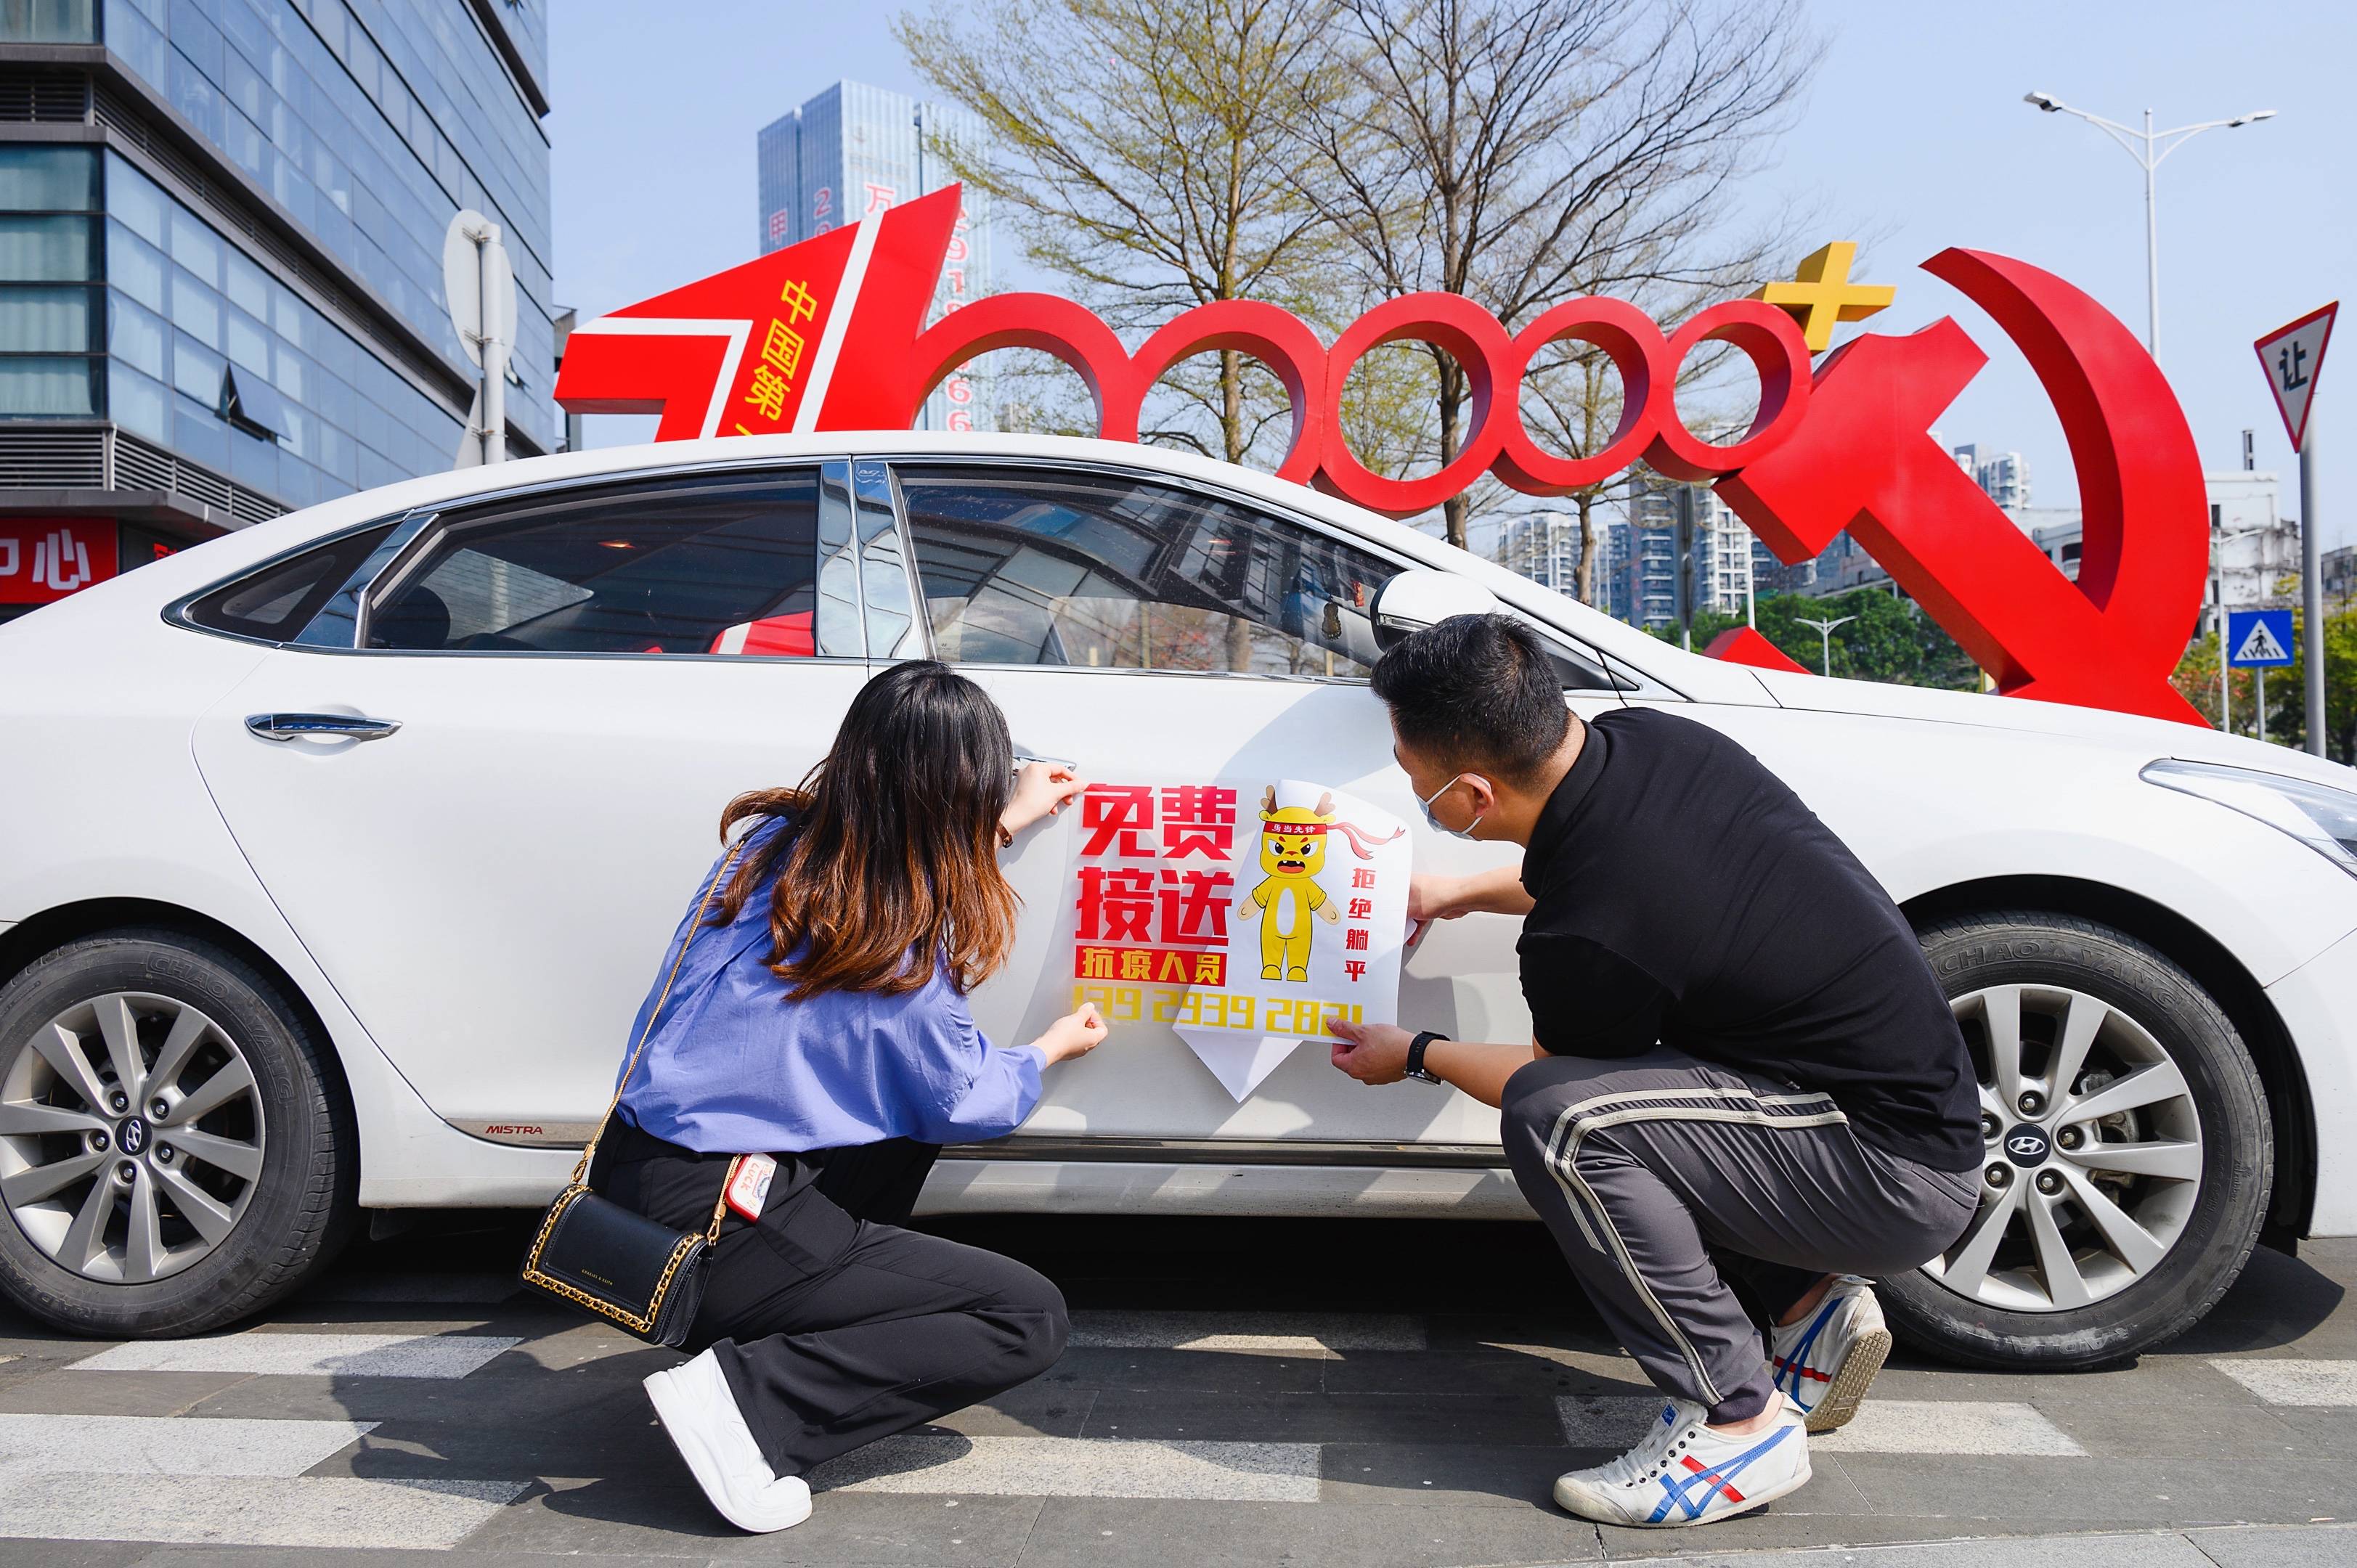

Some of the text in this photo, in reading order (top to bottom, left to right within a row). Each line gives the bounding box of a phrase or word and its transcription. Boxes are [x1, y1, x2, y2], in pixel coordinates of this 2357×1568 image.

[2279, 340, 2308, 392] 让
[1080, 783, 1237, 860] 免费
[1271, 823, 1316, 834] 勇当先锋
[1075, 866, 1234, 947] 接送
[1344, 867, 1375, 982] 拒绝躺平
[150, 957, 229, 999] CHAO
[1082, 948, 1221, 984] 抗疫人员
[1939, 942, 2182, 1010] CHAO YANG
[1152, 989, 1255, 1030] 2939
[485, 1125, 543, 1135] MISTRA
[741, 1163, 760, 1191] LUCK
